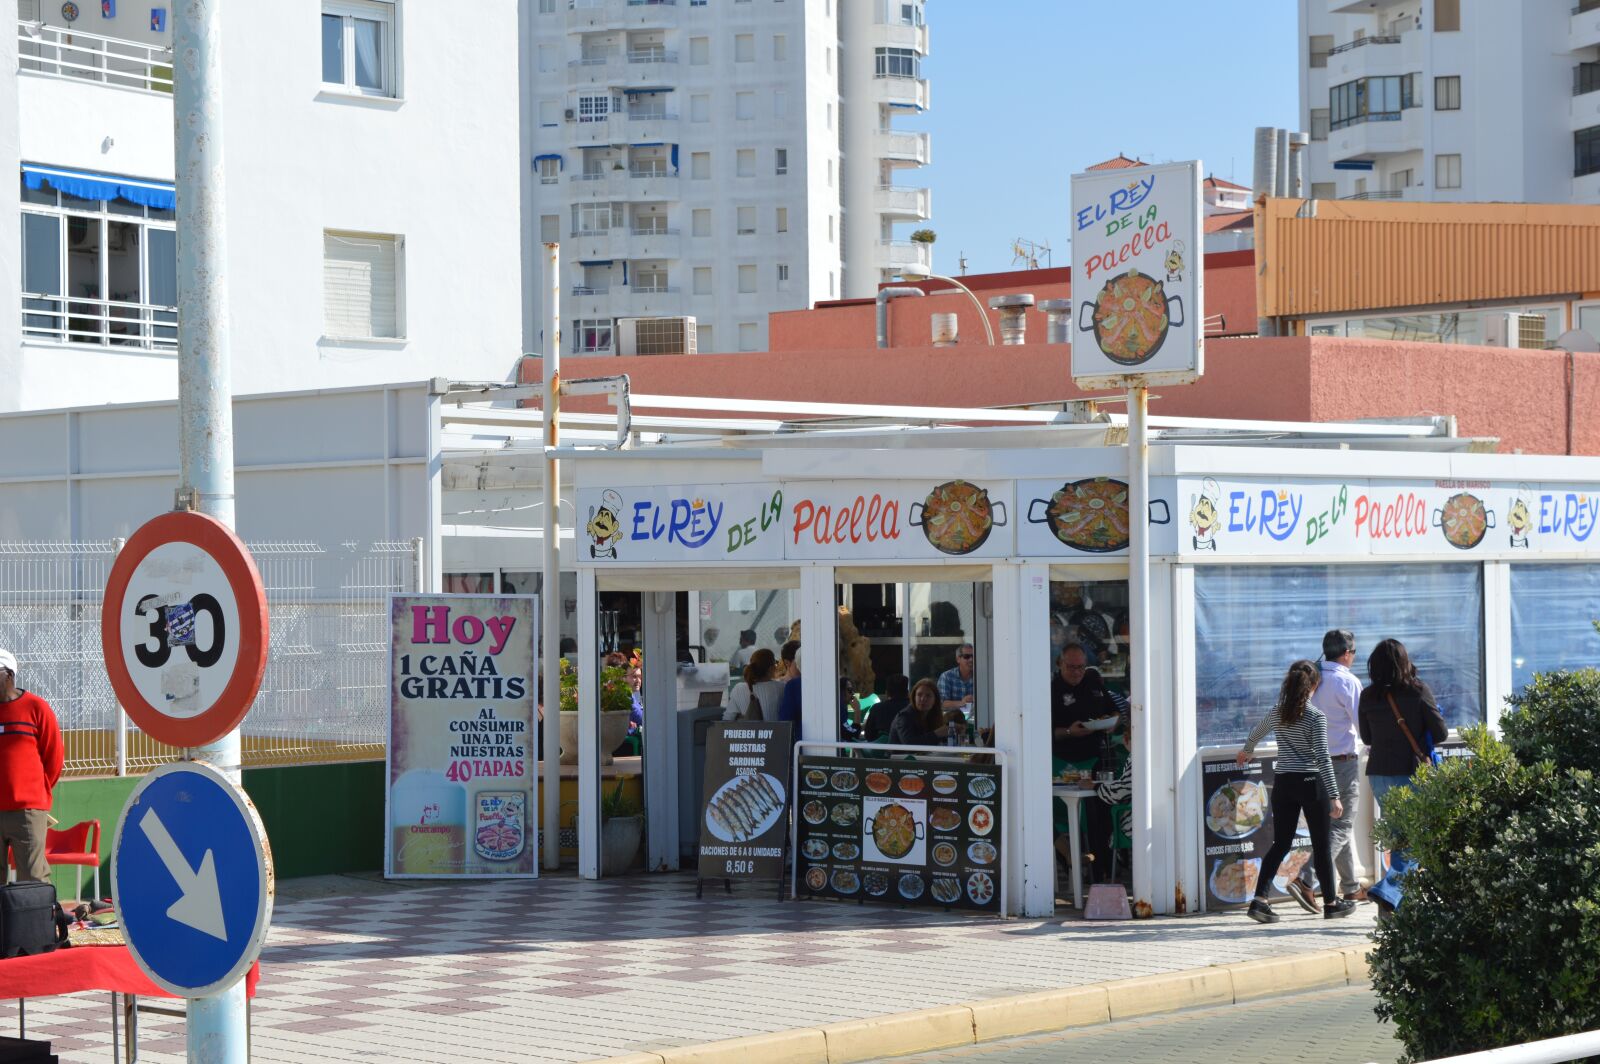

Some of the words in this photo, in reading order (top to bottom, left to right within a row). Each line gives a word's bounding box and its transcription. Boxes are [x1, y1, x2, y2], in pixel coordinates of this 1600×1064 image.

[1109, 174, 1155, 215] REY
[1105, 212, 1133, 237] DE
[1138, 204, 1157, 230] LA
[1084, 221, 1172, 280] Paella
[668, 498, 724, 548] REY
[727, 517, 757, 553] DE
[760, 489, 783, 532] LA
[793, 493, 900, 544] Paella
[1258, 490, 1303, 541] REY
[1306, 510, 1329, 545] DE
[1331, 484, 1348, 525] LA
[1354, 492, 1428, 539] Paella
[1564, 494, 1599, 541] REY
[135, 593, 226, 668] 30
[411, 605, 517, 655] Hoy
[400, 654, 411, 675] 1
[420, 650, 498, 675] CAÑA
[400, 676, 525, 699] GRATIS
[478, 708, 496, 720] AL
[449, 720, 524, 732] CONSUMIR
[723, 729, 756, 739] PRUEBEN
[758, 729, 773, 739] HOY
[461, 733, 491, 744] UNA
[495, 733, 513, 745] DE
[729, 743, 766, 753] NUESTRAS
[450, 746, 524, 757] NUESTRAS
[728, 757, 765, 767] SARDINAS
[445, 760, 472, 782] 40
[473, 760, 524, 777] TAPAS
[700, 846, 729, 856] RACIONES
[729, 846, 737, 856] DE
[753, 847, 781, 857] UNIDADES
